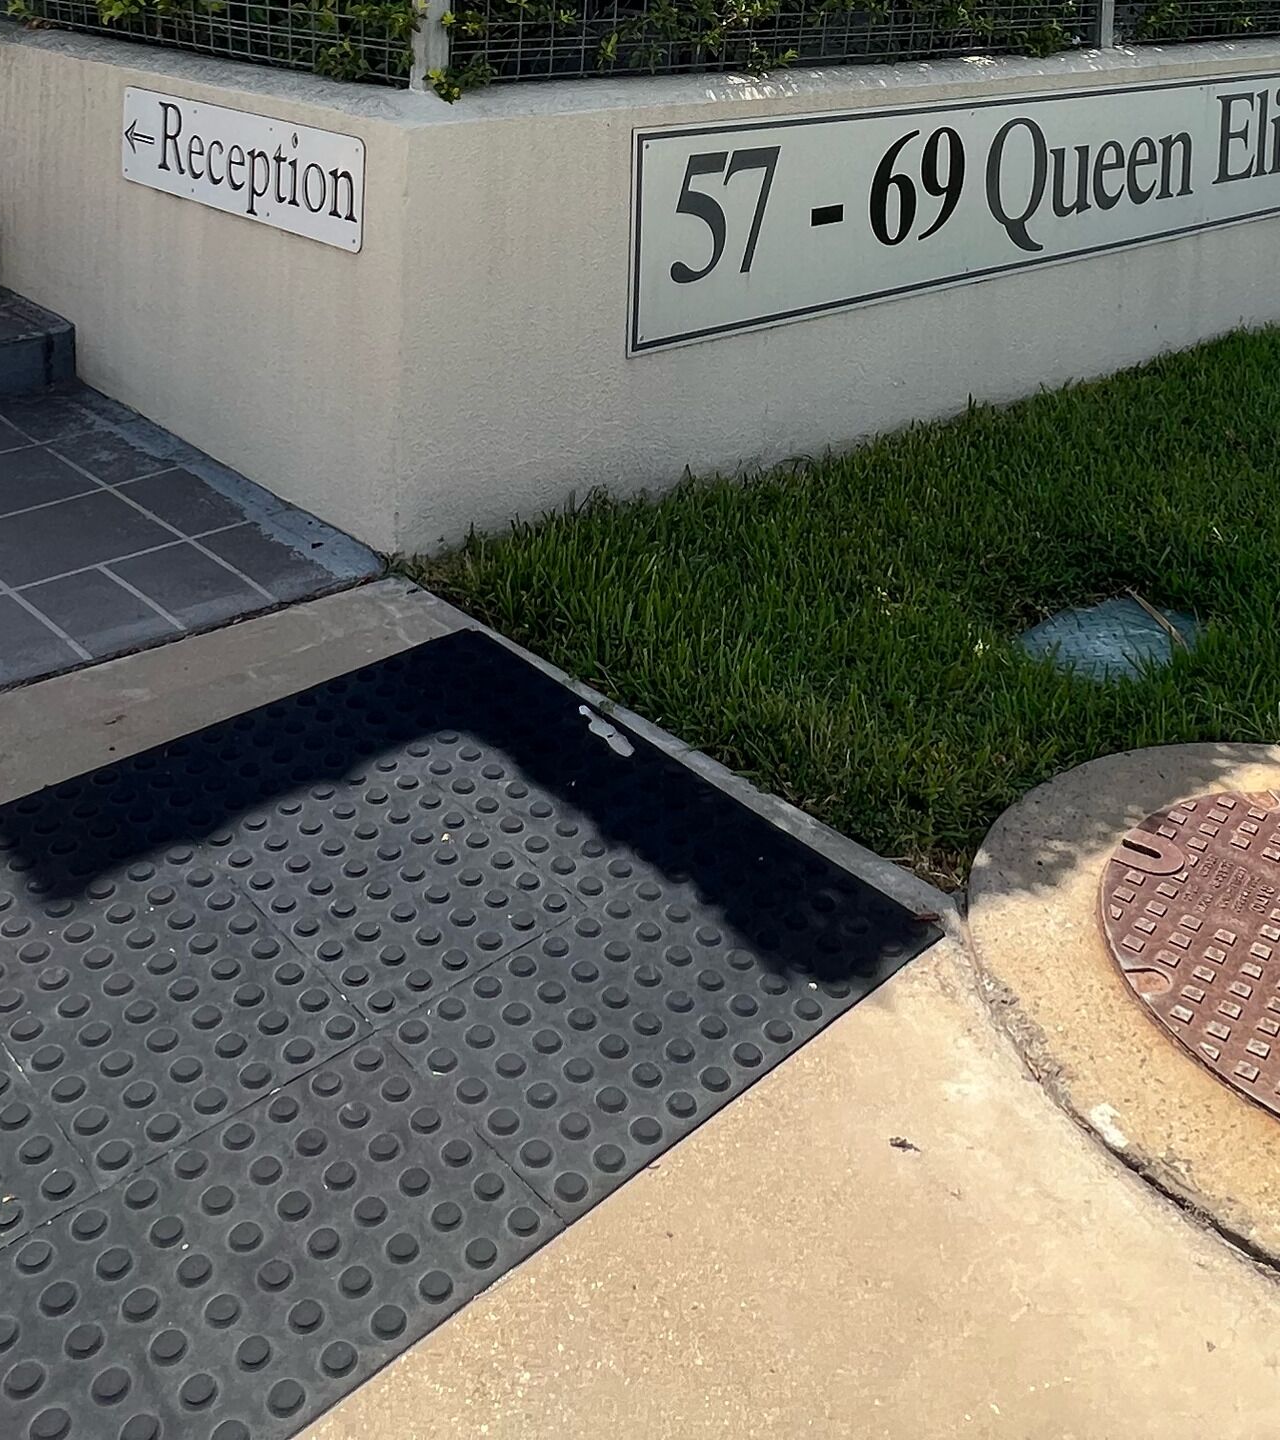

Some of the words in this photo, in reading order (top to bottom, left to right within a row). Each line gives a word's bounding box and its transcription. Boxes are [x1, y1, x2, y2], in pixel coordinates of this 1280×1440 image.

[157, 101, 358, 223] Reception
[669, 145, 782, 284] 57
[869, 126, 966, 247] 69
[985, 117, 1194, 252] Queen
